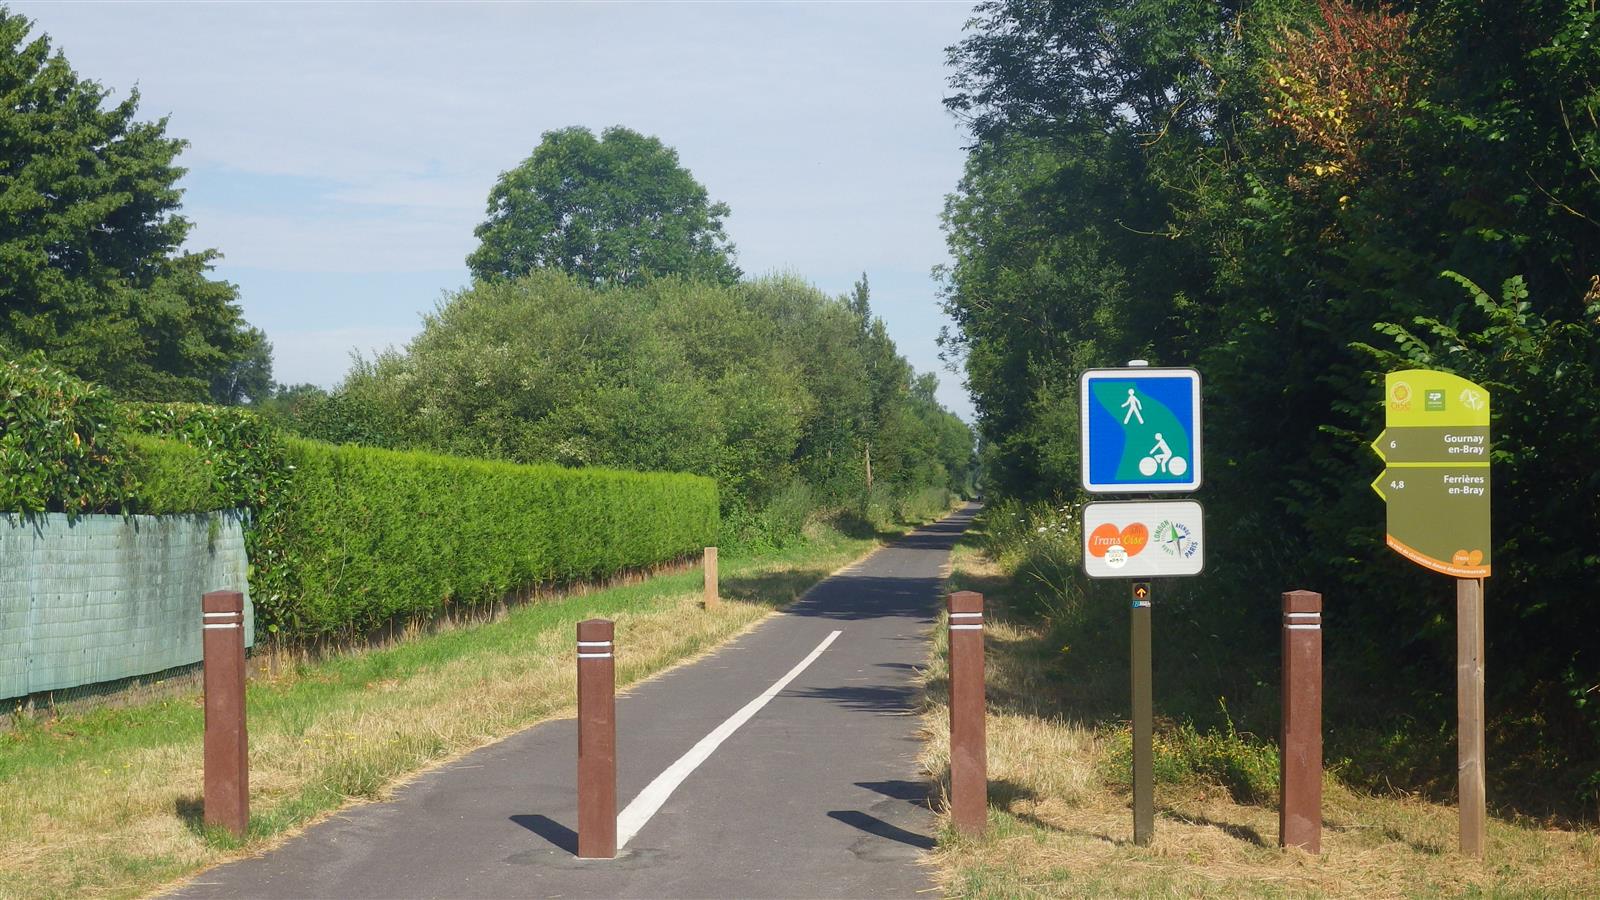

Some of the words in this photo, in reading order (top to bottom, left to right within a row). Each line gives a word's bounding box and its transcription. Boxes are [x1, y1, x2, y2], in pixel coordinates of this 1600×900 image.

[1390, 440, 1396, 448] 6
[1444, 434, 1484, 444] Gournay
[1448, 445, 1484, 455] en-Bray
[1444, 475, 1484, 483] Ferrières
[1390, 480, 1404, 489] 4,8
[1448, 486, 1484, 496] en-Bray
[1184, 541, 1198, 559] PARIS
